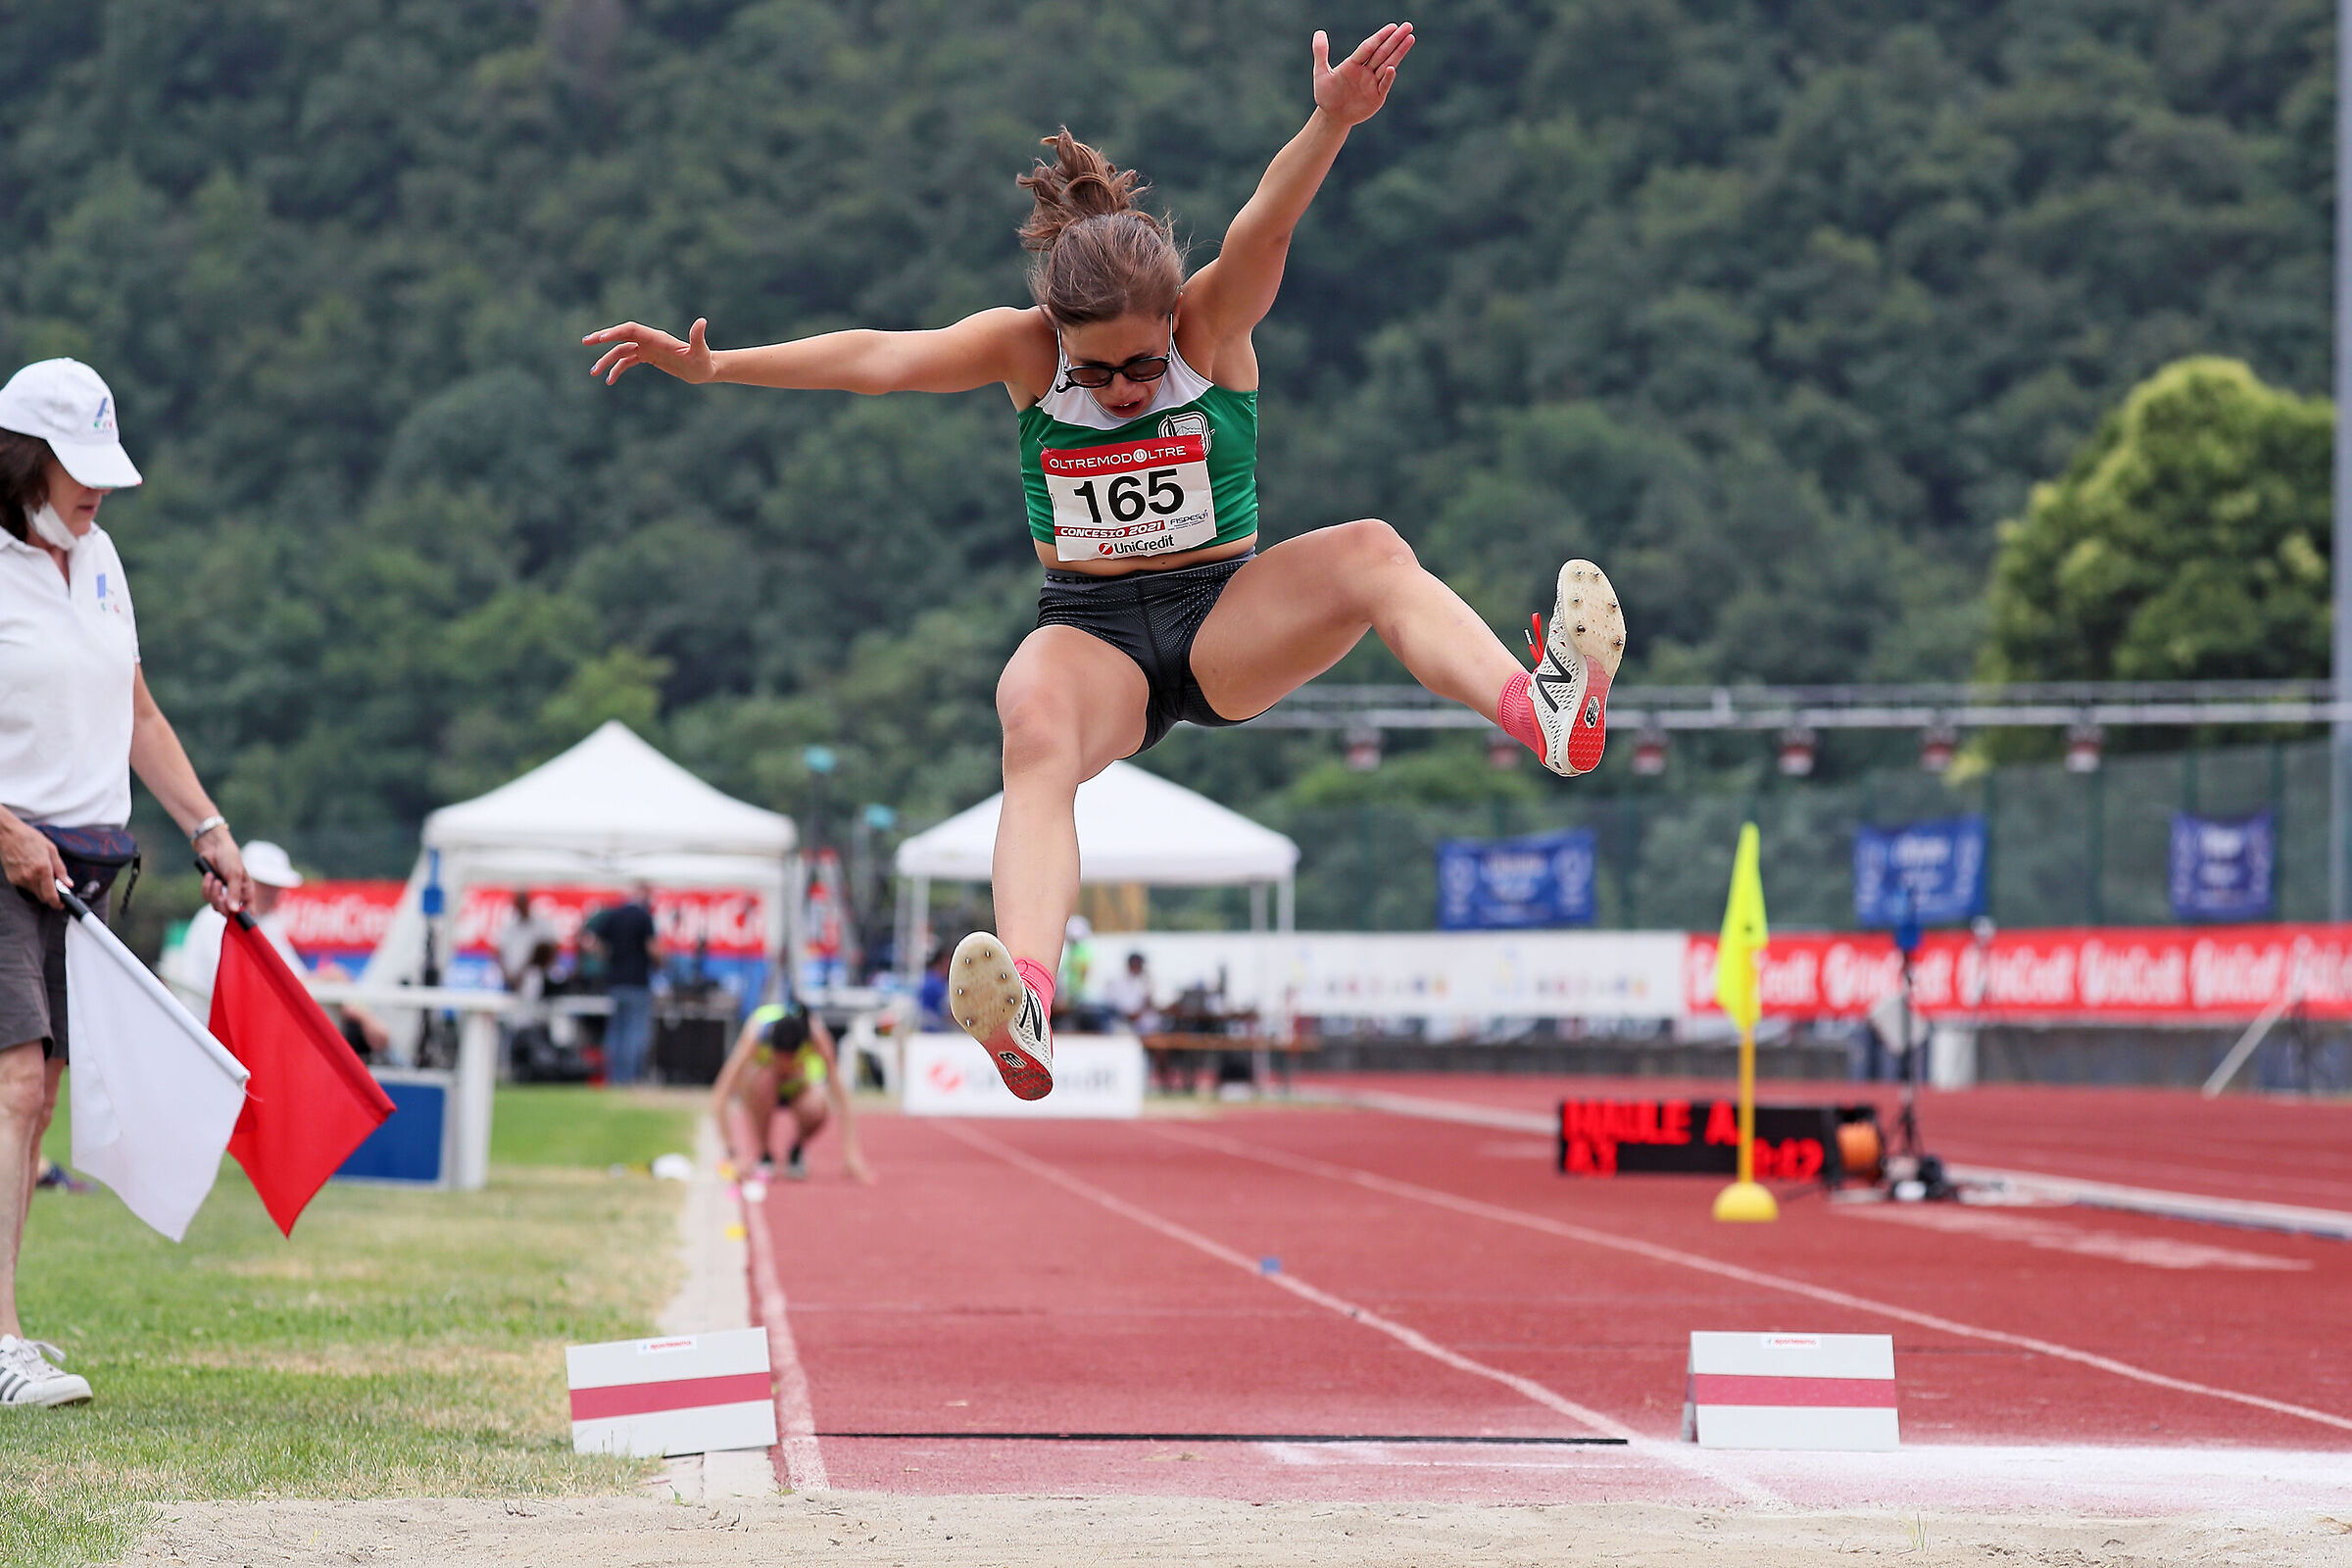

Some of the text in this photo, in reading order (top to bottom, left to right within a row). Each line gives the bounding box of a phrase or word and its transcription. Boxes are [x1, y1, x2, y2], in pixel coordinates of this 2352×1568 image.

[1049, 445, 1187, 469] OLTREMODOLTRE
[1073, 467, 1185, 523] 165
[1059, 527, 1125, 538] CONCESIO
[1128, 521, 1163, 536] 2021
[1113, 534, 1174, 554] UniCredit
